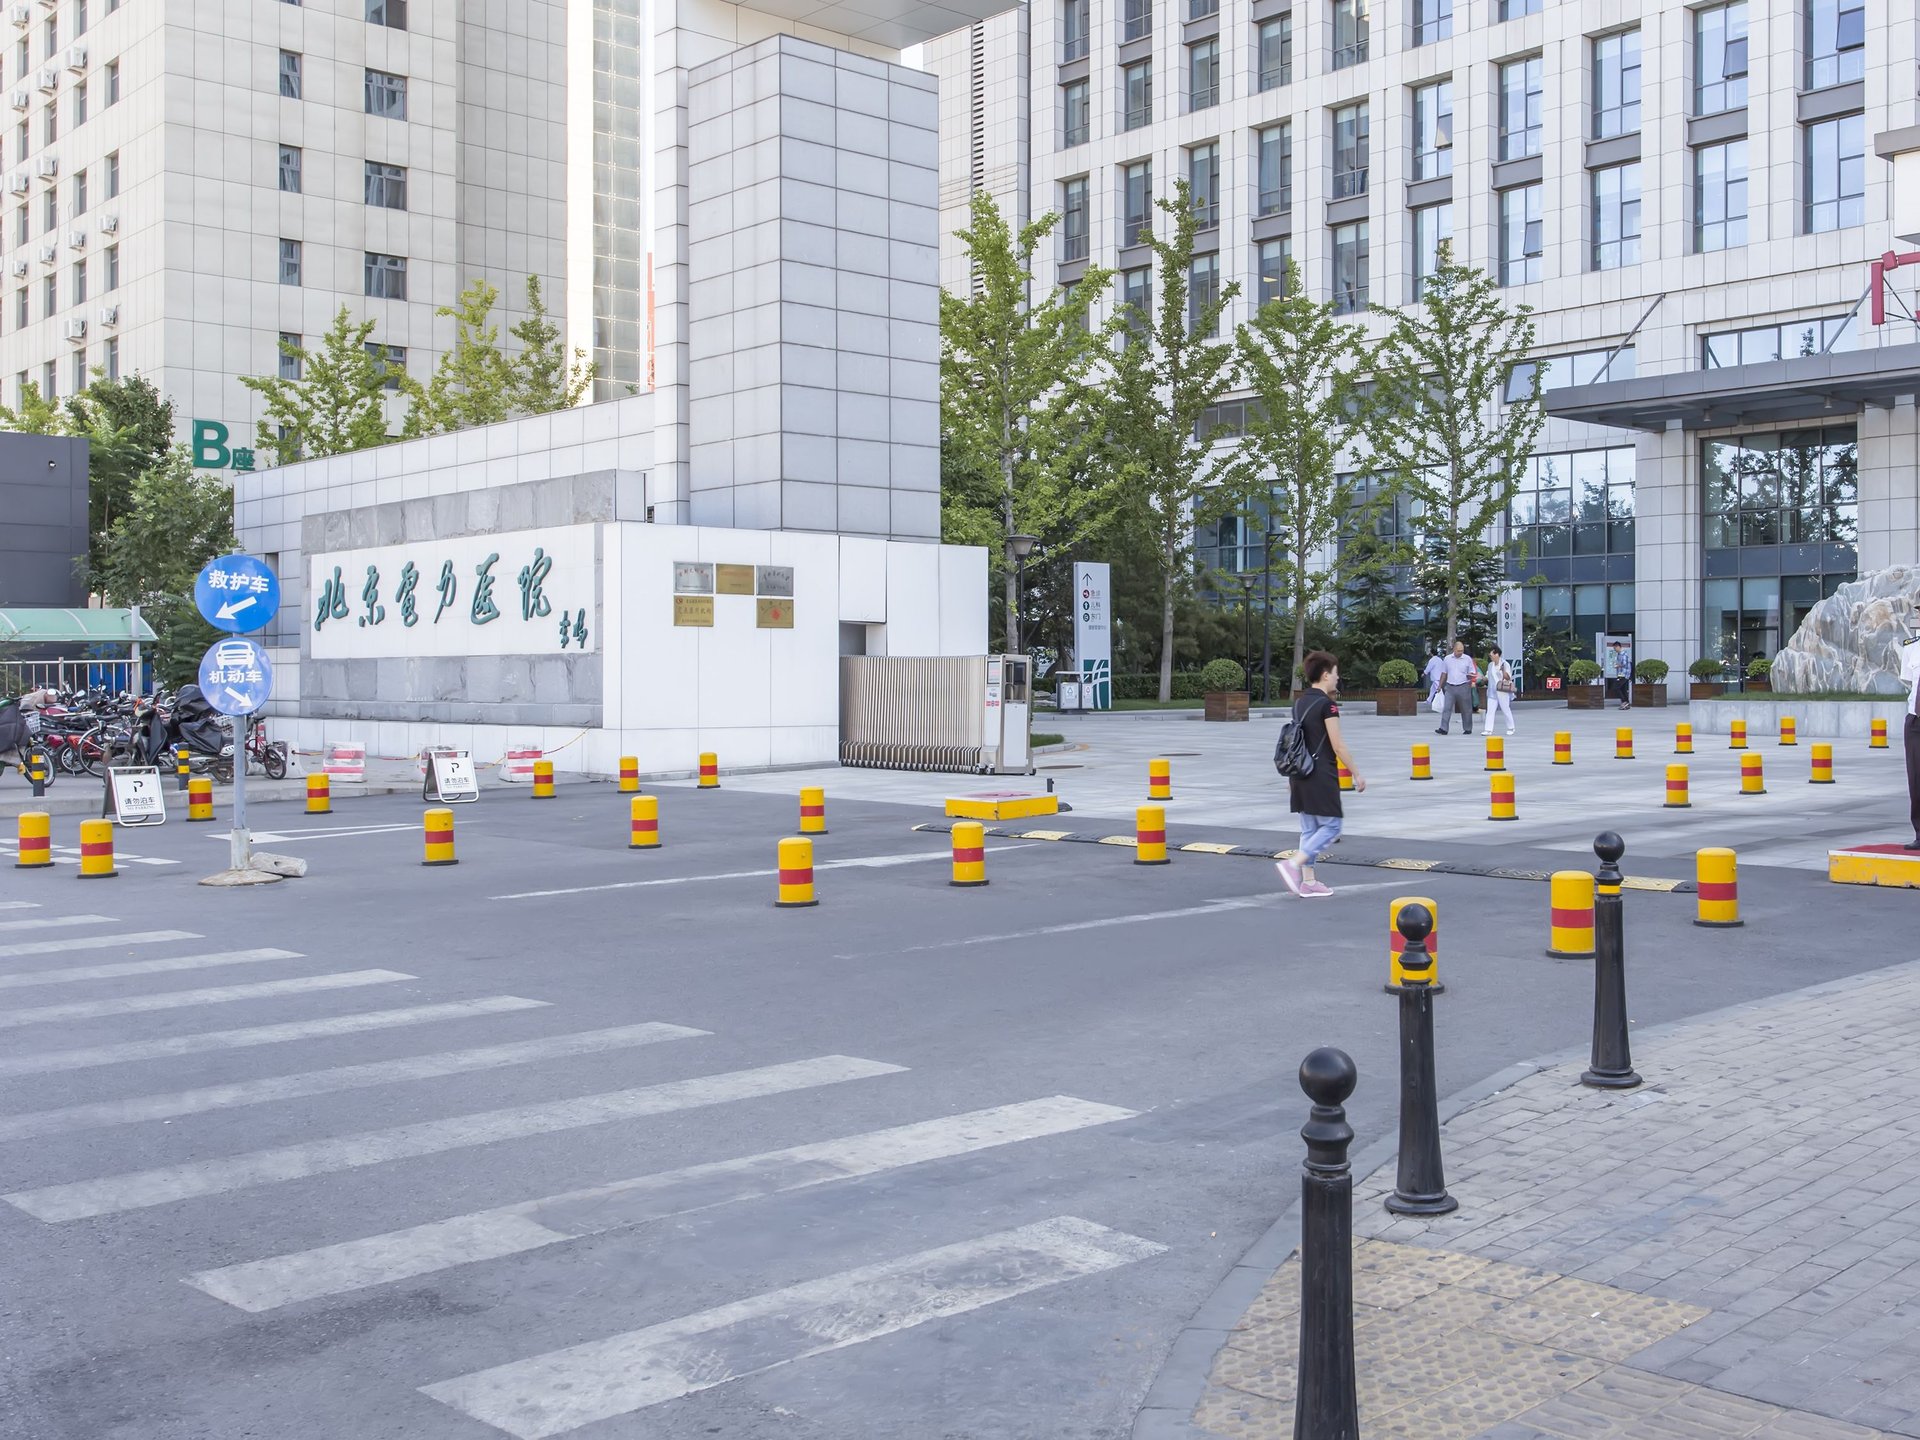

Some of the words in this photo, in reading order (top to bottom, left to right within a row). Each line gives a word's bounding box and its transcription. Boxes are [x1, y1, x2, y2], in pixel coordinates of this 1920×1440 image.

[193, 418, 256, 472] B座
[208, 569, 270, 594] 救护车
[209, 669, 263, 684] 机动车
[444, 776, 470, 784] 请勿泊车
[124, 797, 155, 805] 请勿泊车
